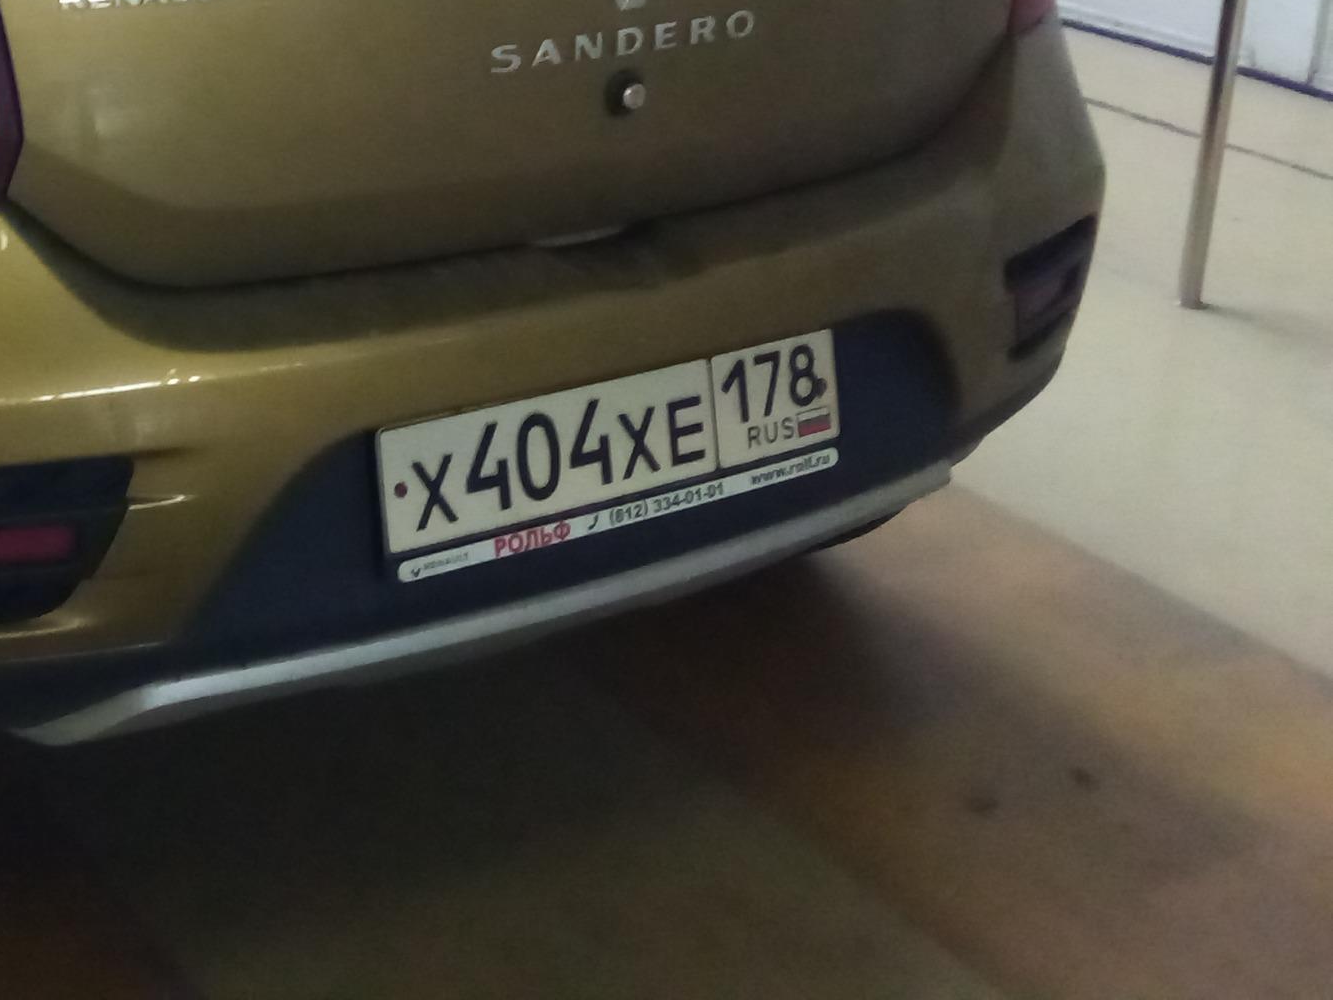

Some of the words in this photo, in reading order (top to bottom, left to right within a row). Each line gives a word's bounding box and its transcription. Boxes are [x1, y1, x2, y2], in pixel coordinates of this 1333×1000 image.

[491, 10, 755, 73] SANDERO
[721, 344, 817, 423] 178
[747, 417, 795, 448] RUS
[494, 519, 571, 558] РОЛЬФ
[609, 499, 649, 526] (812)
